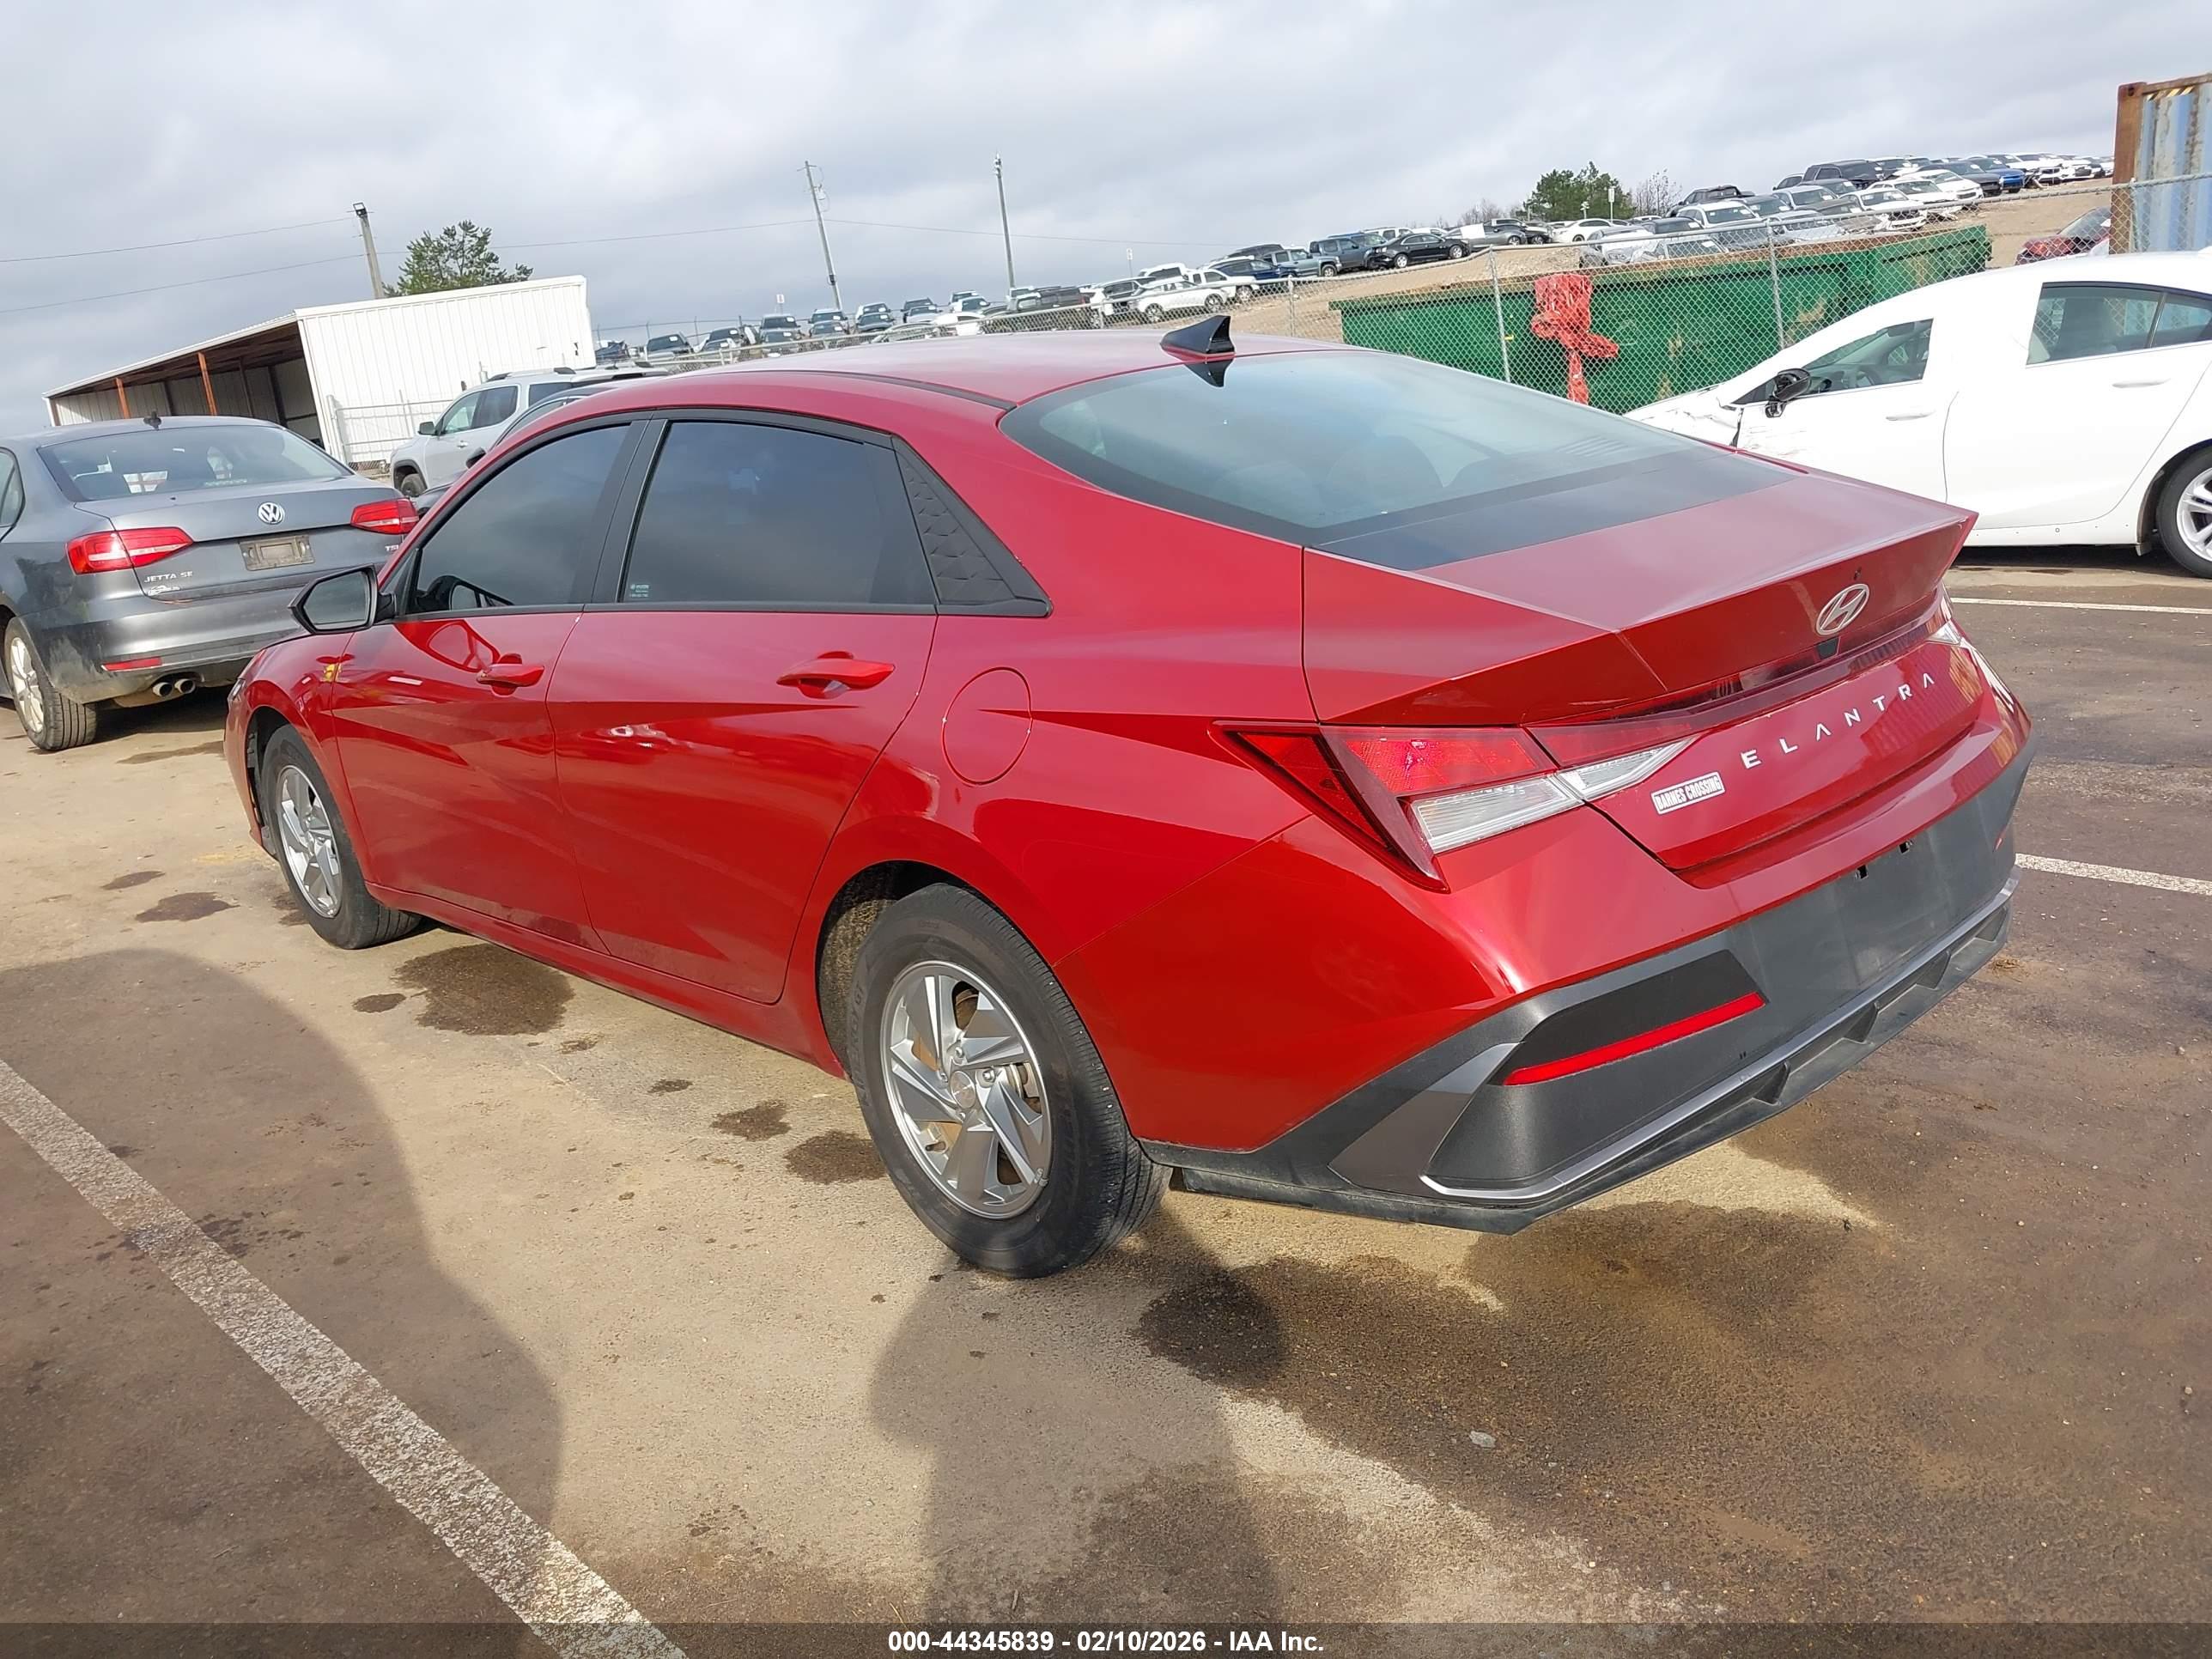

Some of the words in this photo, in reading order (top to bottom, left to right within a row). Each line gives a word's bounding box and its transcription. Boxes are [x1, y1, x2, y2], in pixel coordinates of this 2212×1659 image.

[144, 573, 177, 583] JETTA
[1740, 672, 1935, 769] ELANTRA
[1654, 787, 1687, 810] BARNES
[1684, 775, 1721, 800] CROSSING
